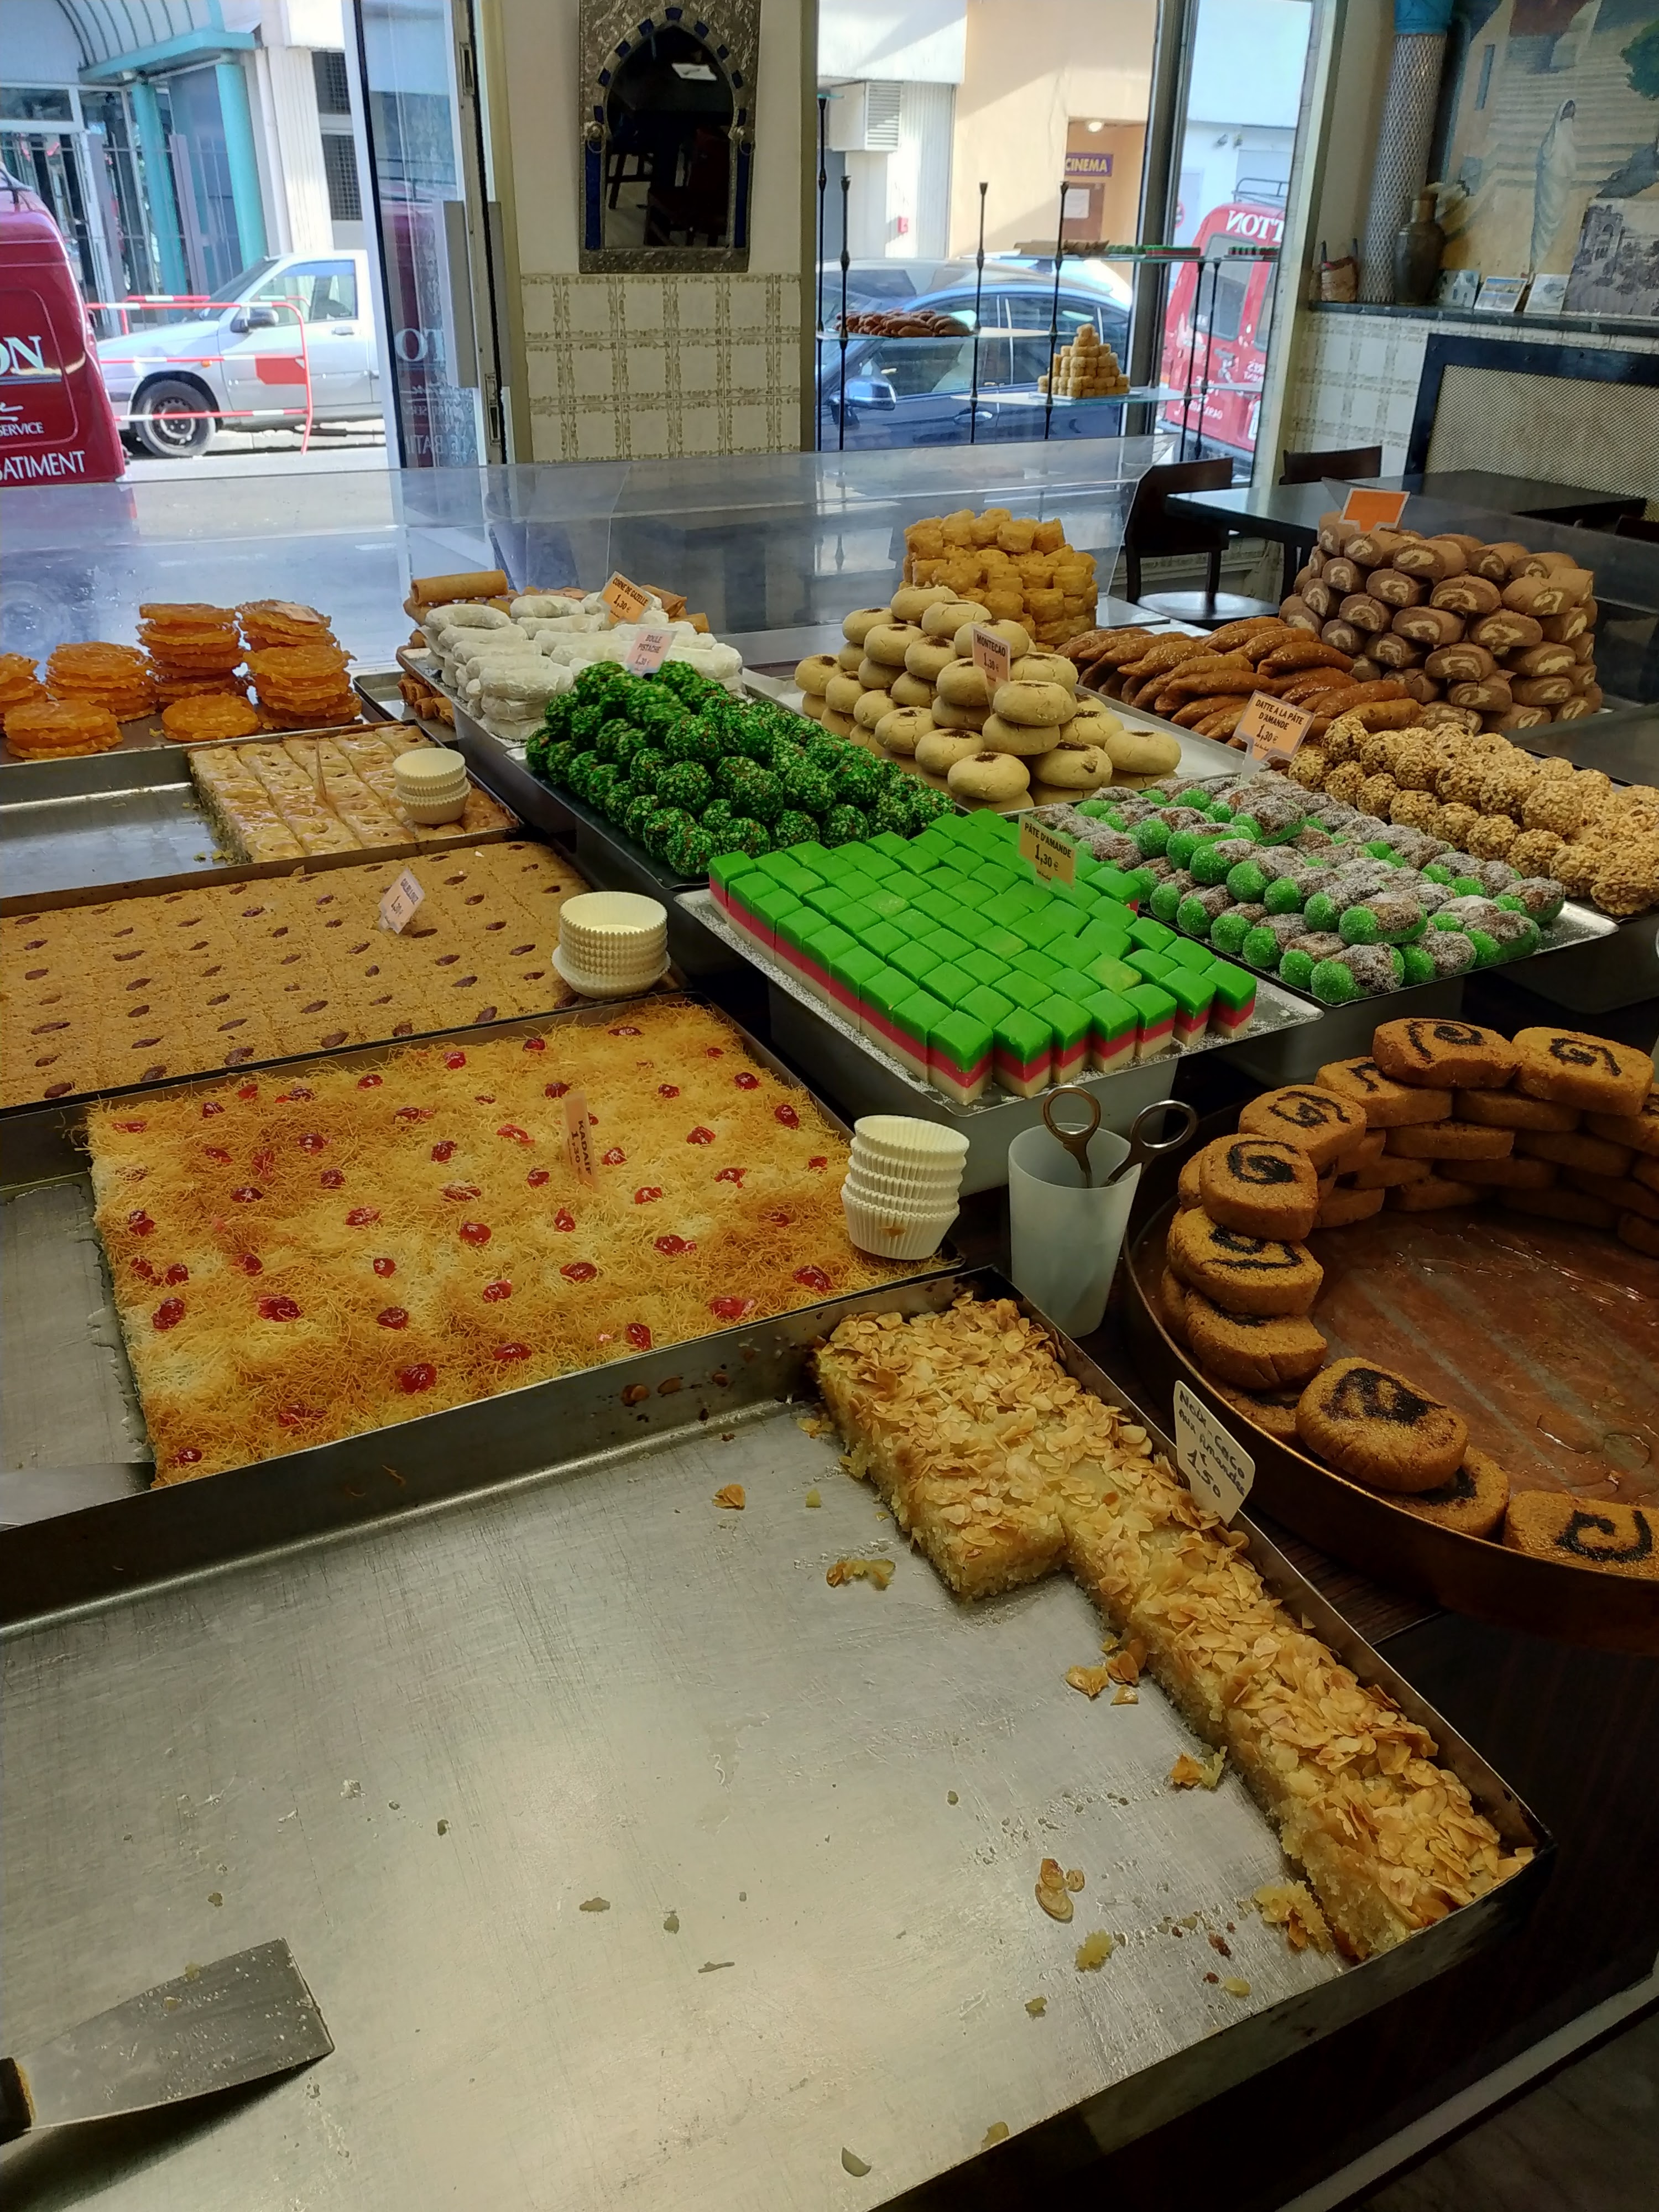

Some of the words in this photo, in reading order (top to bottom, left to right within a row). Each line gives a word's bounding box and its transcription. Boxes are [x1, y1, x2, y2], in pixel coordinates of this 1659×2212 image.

[1065, 158, 1108, 173] CINEMA
[612, 577, 628, 593] CORNE
[625, 586, 632, 596] DE
[630, 589, 649, 607] GAZELLE
[613, 594, 628, 611] 1,30
[977, 634, 1006, 657] MONTECAO
[984, 652, 995, 671] 1,30
[1255, 699, 1275, 713] DATTE
[1279, 708, 1287, 719] LA
[1287, 712, 1305, 725] PÂTE
[1258, 712, 1290, 730] D'AMANDE
[1256, 724, 1273, 742] 1,30
[1272, 735, 1279, 744] €
[1024, 823, 1039, 838] PÂTE
[1040, 833, 1072, 859] D'AMANDE
[1035, 843, 1052, 868] 1,30
[1053, 861, 1059, 872] €
[578, 1120, 592, 1176] KADAIF
